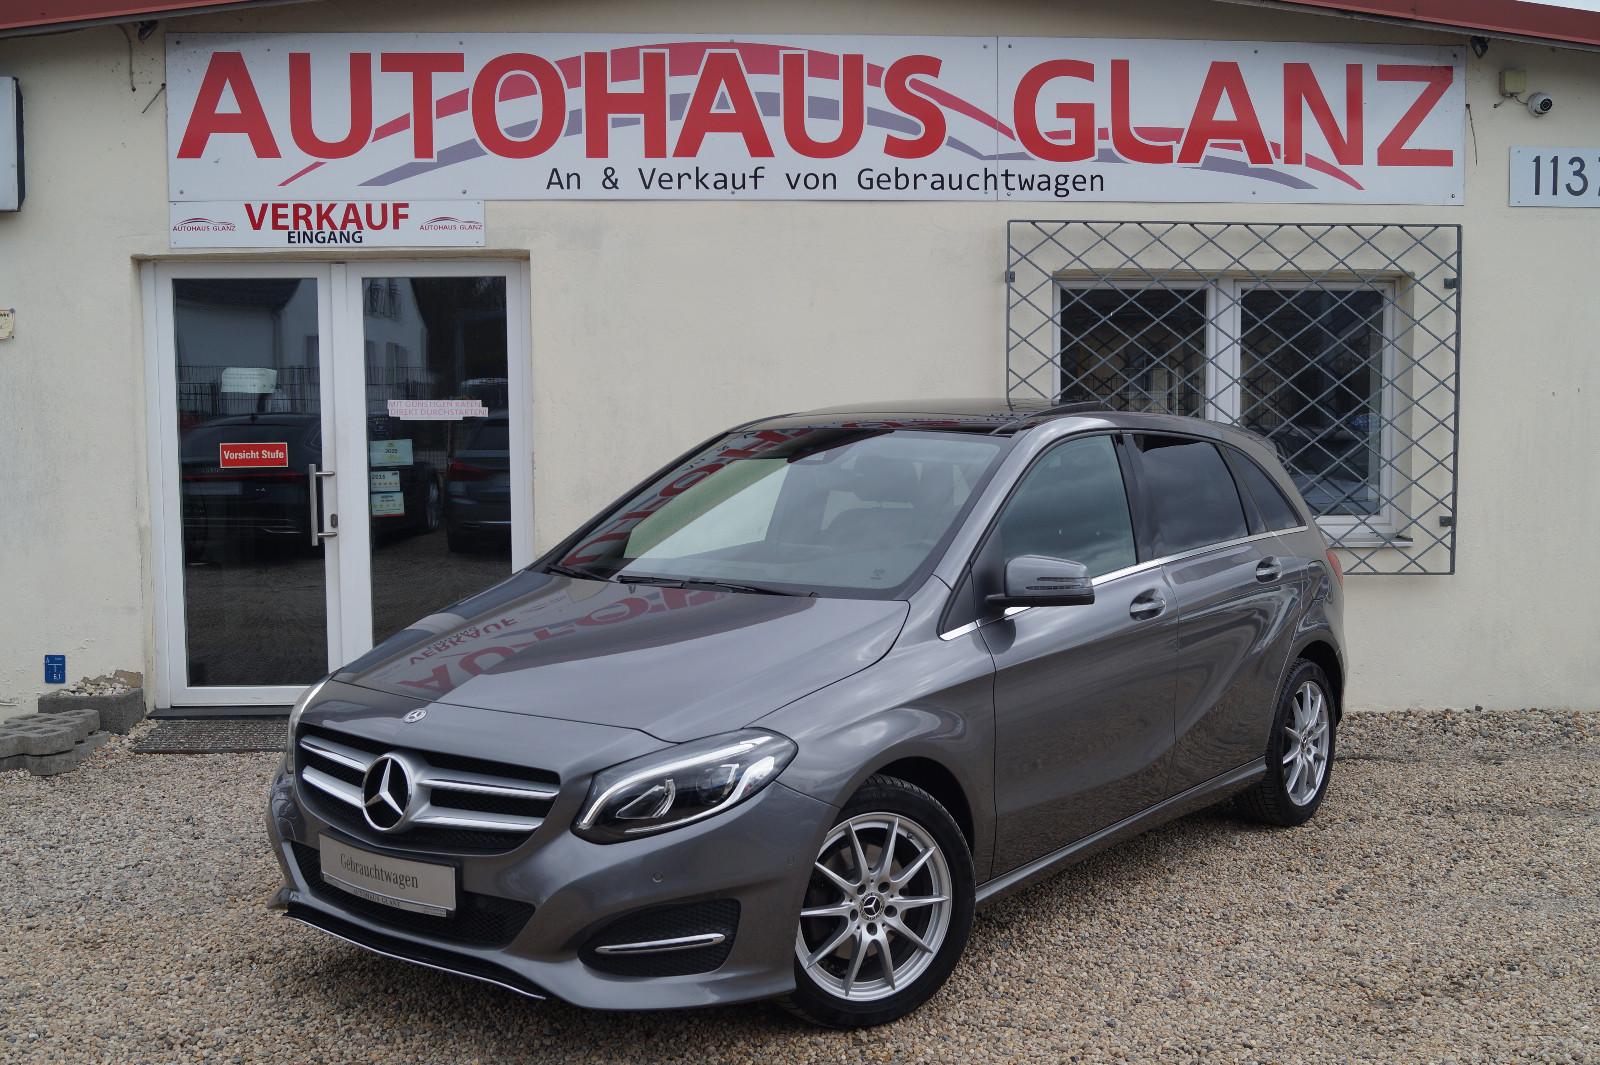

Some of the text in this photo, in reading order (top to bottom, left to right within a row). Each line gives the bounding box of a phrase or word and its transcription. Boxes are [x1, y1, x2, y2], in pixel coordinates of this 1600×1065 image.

[176, 49, 1454, 167] AUTOHAUS GLANZ
[546, 166, 1104, 196] An & Verkauf von Gebrauchtwagen
[245, 203, 409, 231] VERKAUF
[287, 230, 363, 244] EINGANG
[223, 449, 285, 460] Vorsicht Stufe
[340, 853, 419, 889] Gebrauchtwagen
